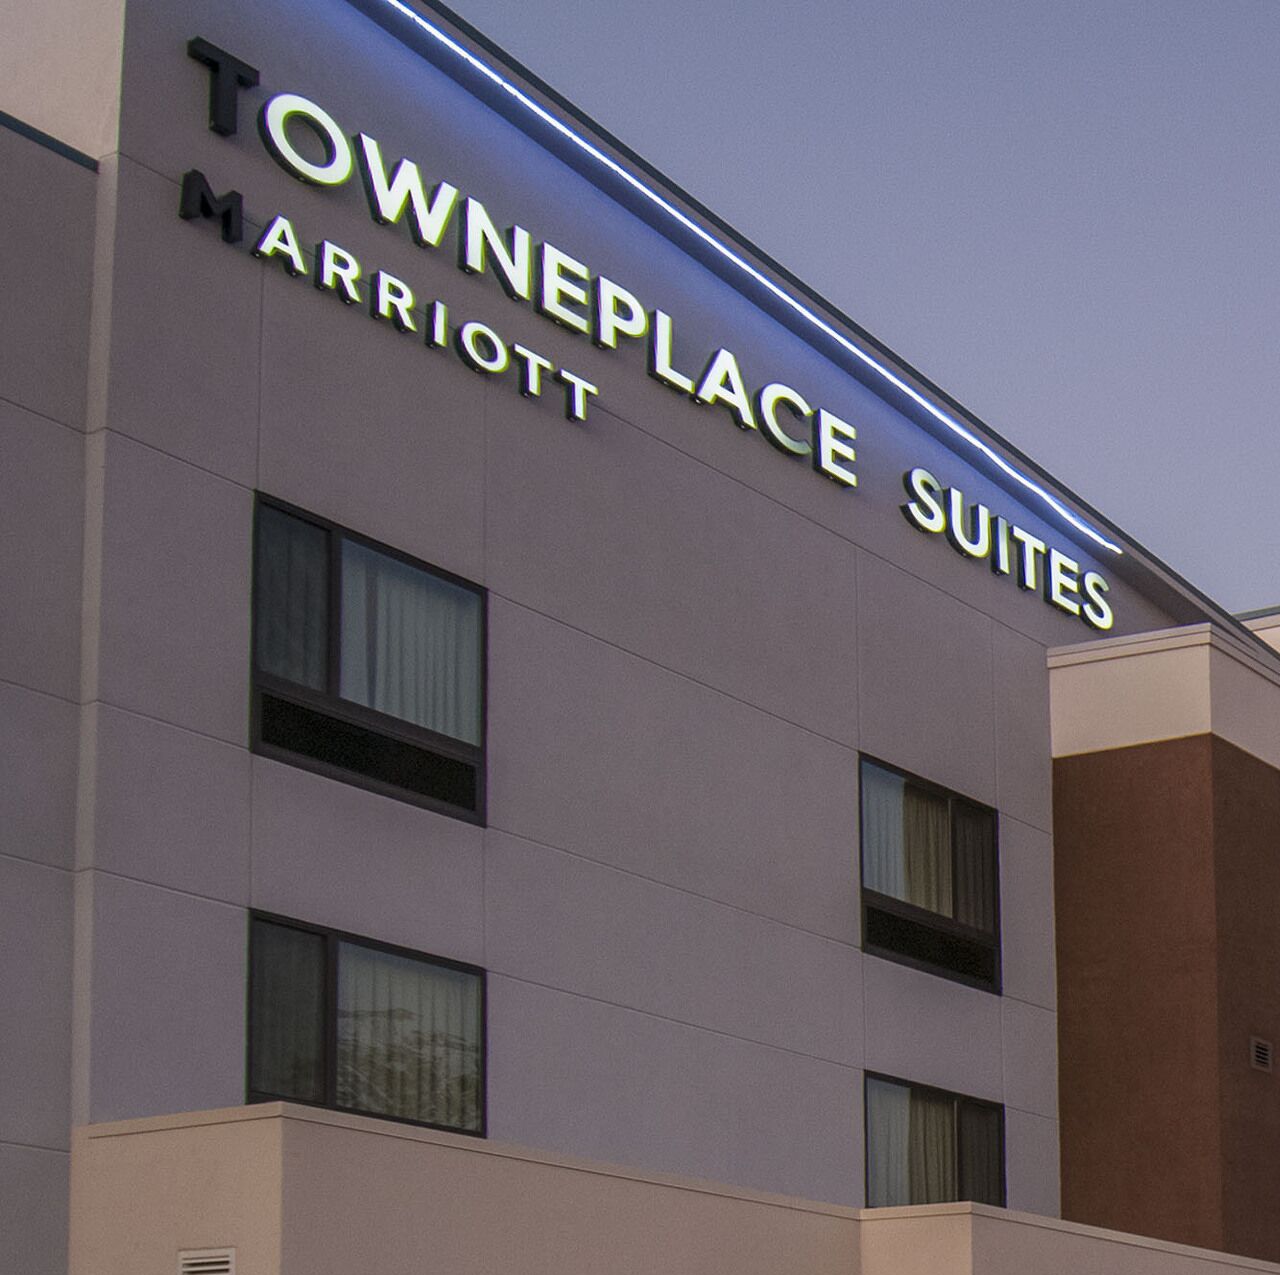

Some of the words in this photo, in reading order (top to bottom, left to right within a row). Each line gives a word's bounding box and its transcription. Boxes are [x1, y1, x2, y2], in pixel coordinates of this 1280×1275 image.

[179, 168, 598, 422] MARRIOTT
[188, 36, 858, 488] TOWNEPLACE
[900, 467, 1113, 630] SUITES
